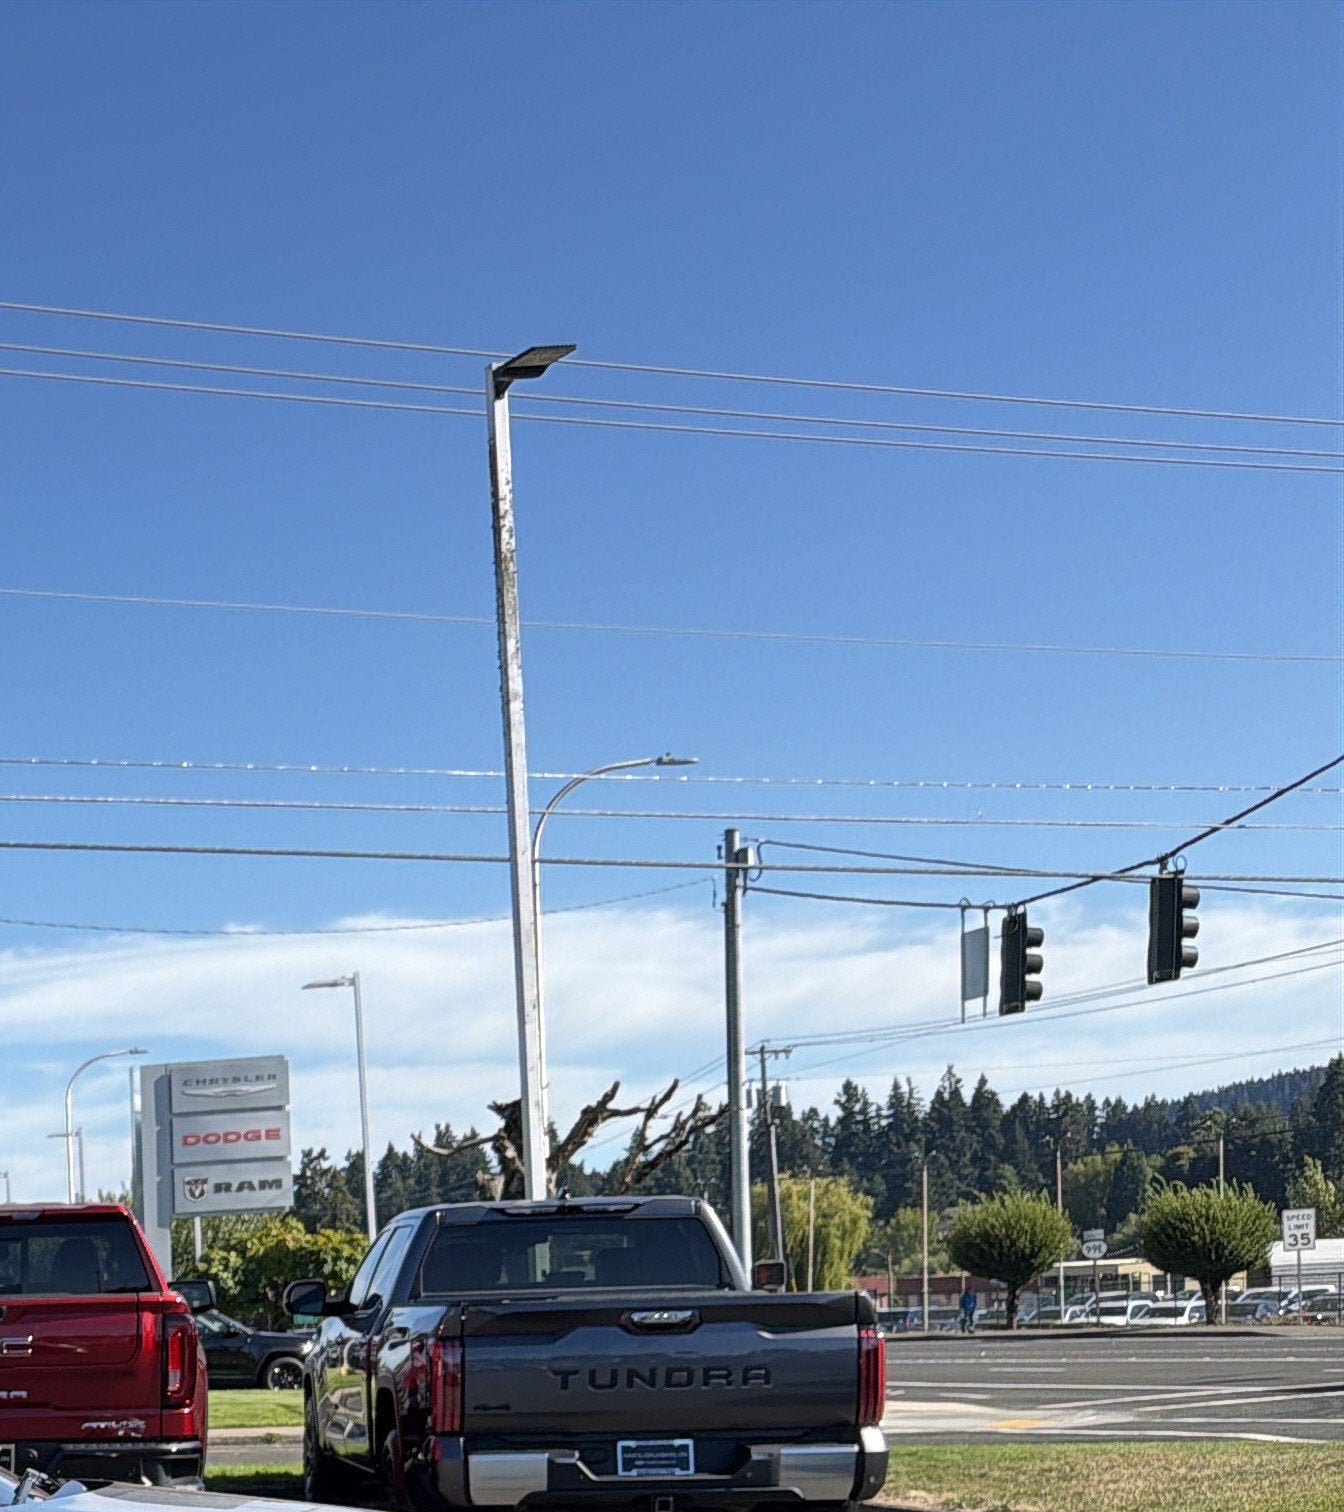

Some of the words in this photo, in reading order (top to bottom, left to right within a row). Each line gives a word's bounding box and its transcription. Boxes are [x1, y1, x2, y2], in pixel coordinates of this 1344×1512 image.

[182, 1073, 278, 1087] CHRYSLER
[182, 1127, 281, 1147] DODGE
[213, 1178, 283, 1194] RAM
[1285, 1213, 1312, 1222] SPEED
[1287, 1223, 1309, 1231] LIMIT
[1287, 1232, 1311, 1247] 35
[548, 1364, 774, 1392] TUNDRA
